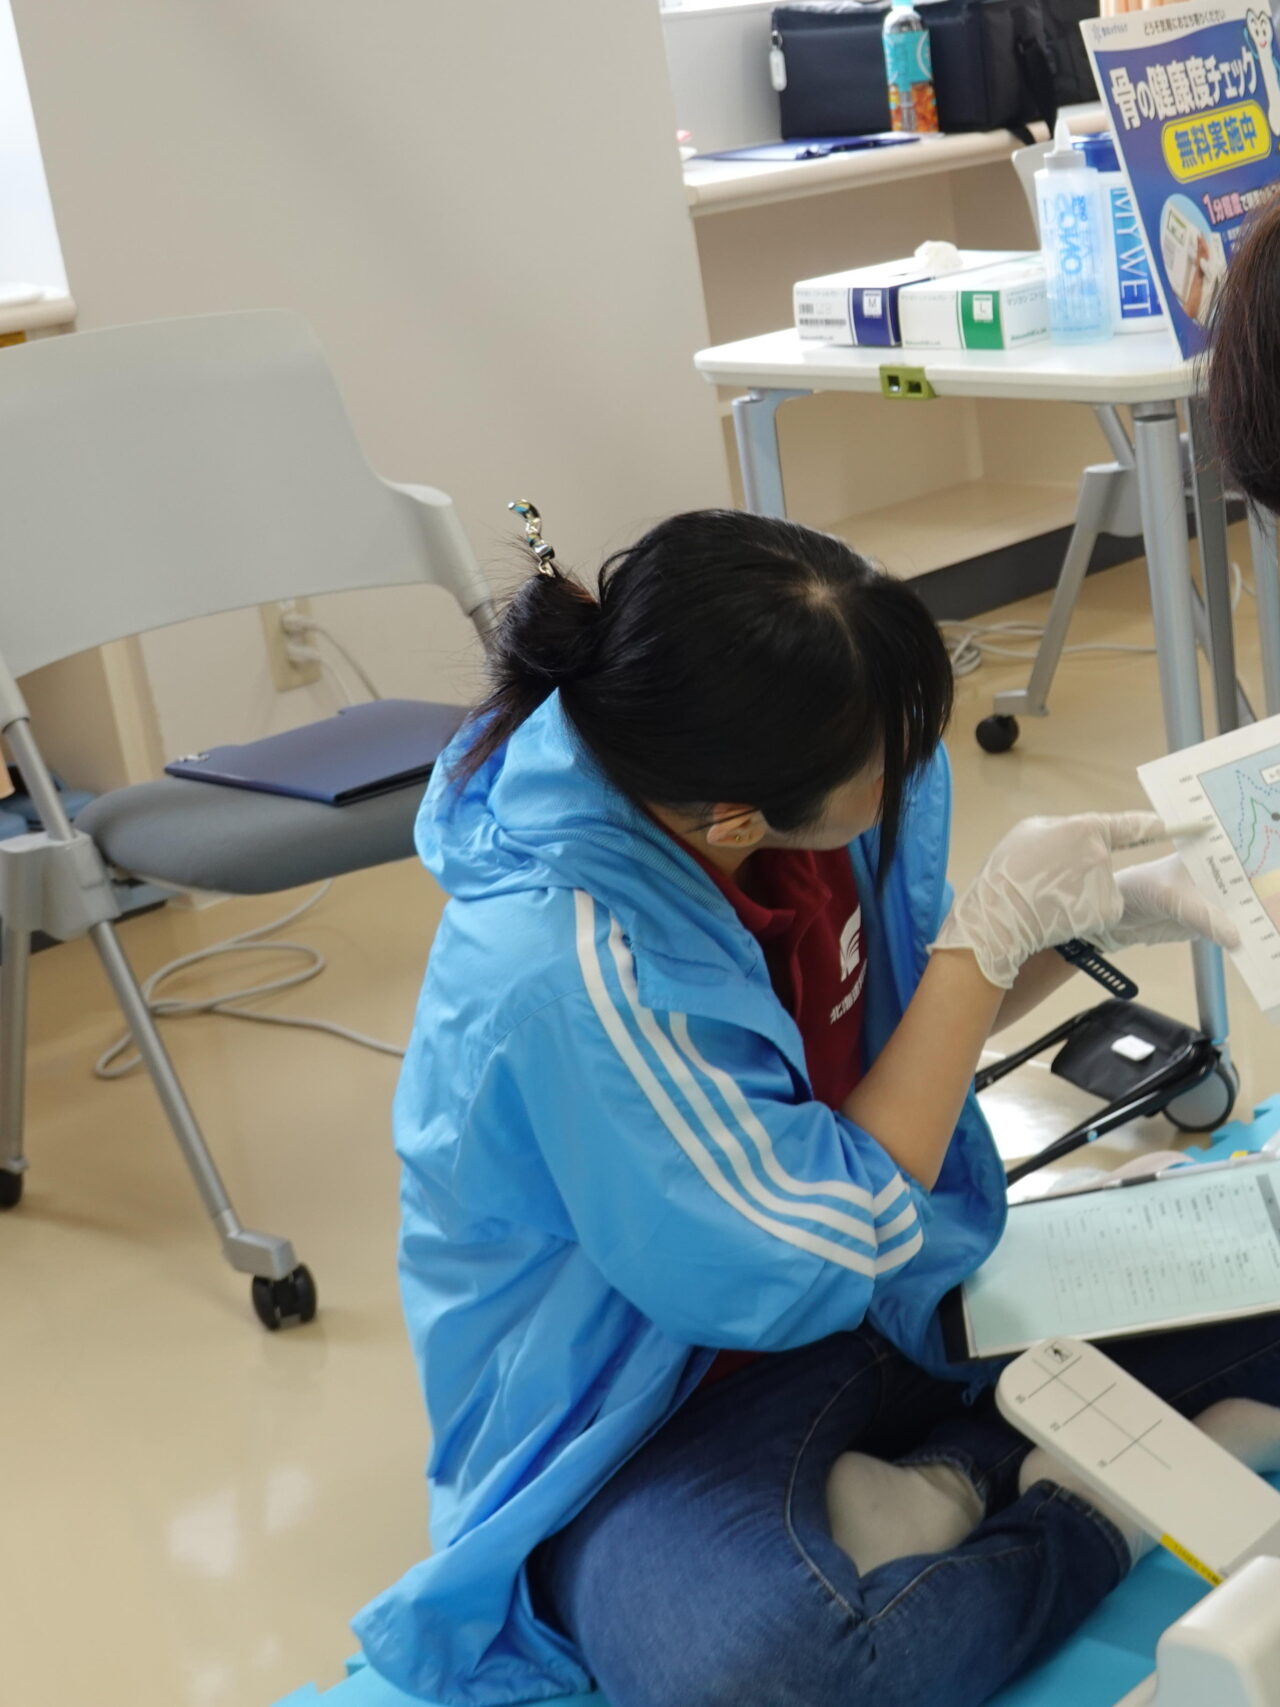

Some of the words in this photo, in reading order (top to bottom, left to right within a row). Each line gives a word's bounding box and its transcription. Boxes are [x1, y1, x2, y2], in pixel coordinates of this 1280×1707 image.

[1109, 45, 1257, 131] 骨の健康度チェック
[1174, 112, 1257, 169] 無料実施中
